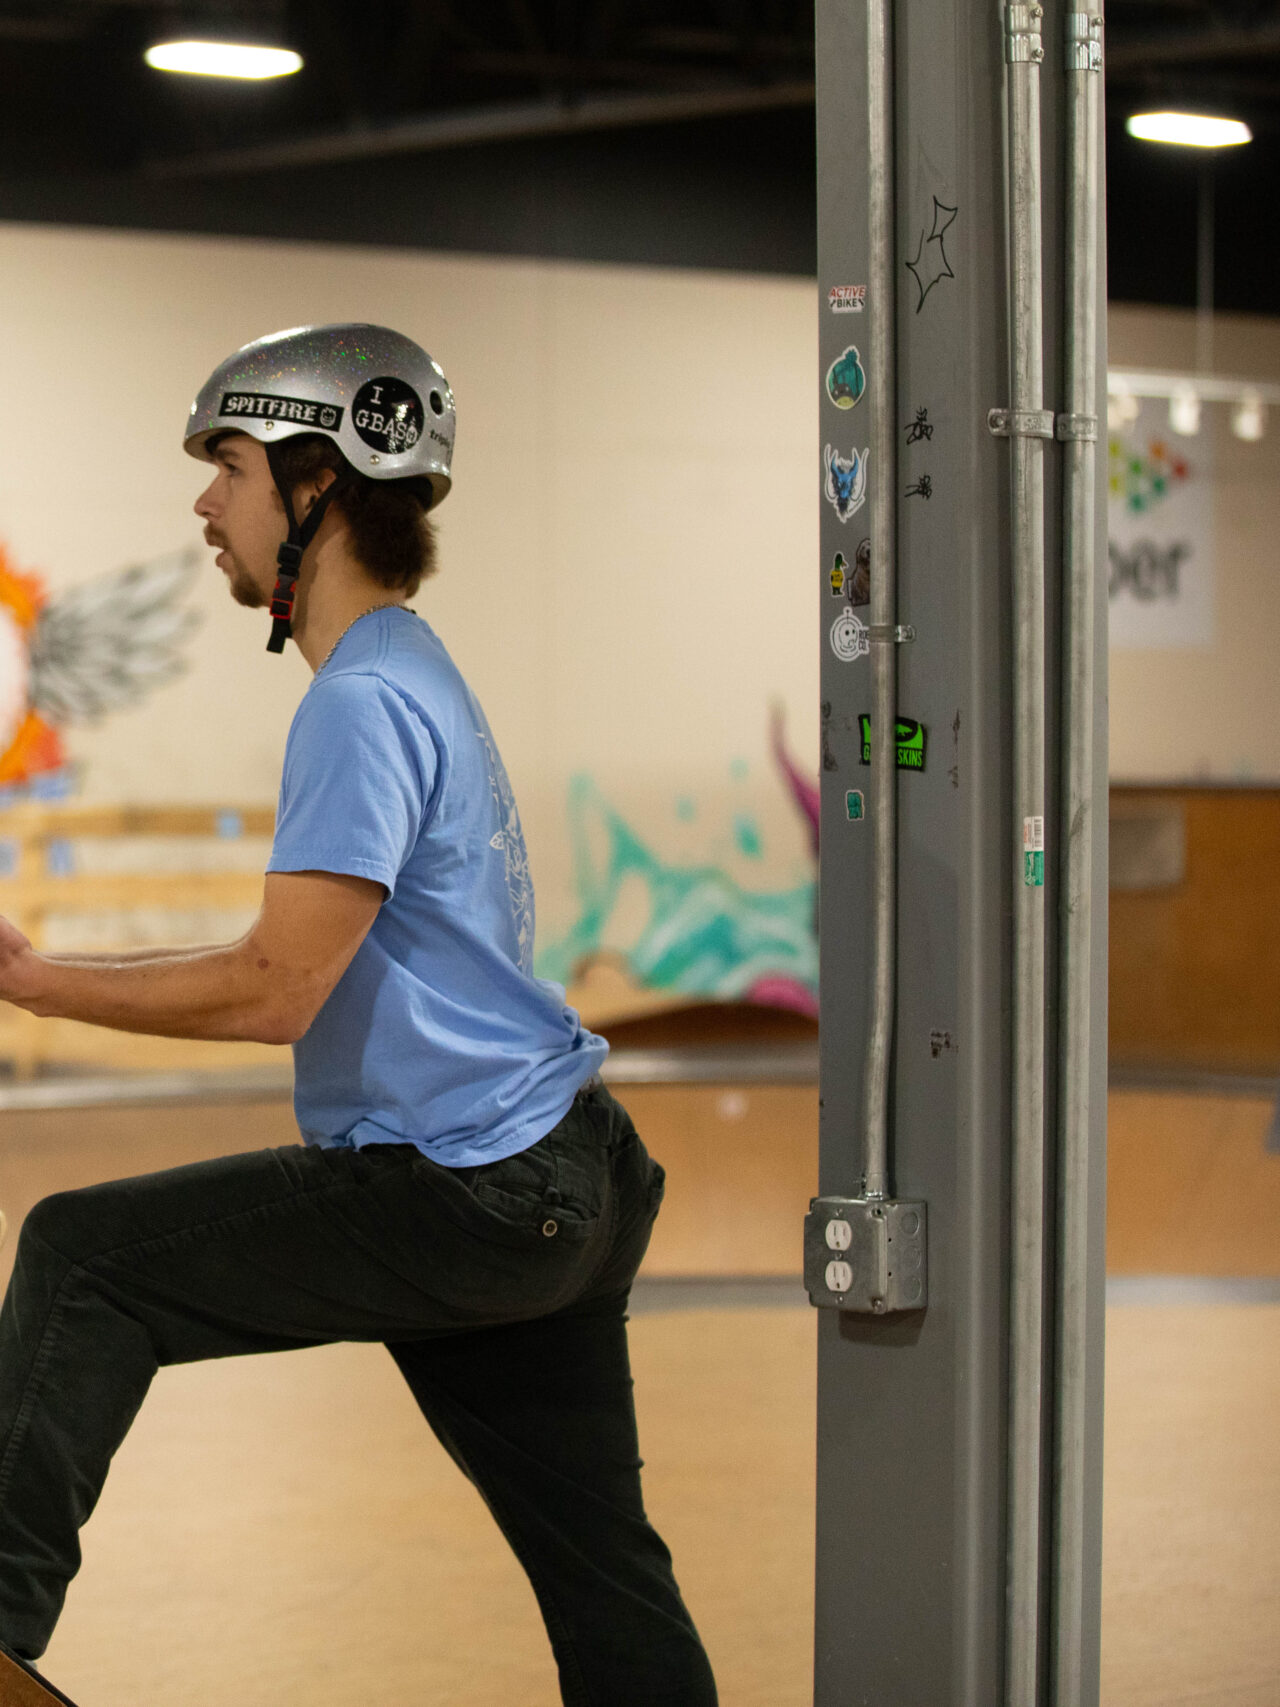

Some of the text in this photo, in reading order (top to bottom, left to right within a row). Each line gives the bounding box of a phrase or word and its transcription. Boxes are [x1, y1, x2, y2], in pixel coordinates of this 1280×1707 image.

[829, 286, 865, 298] ACTIVE
[837, 298, 858, 308] BIKE
[224, 396, 318, 422] SPITFIRE
[897, 748, 923, 768] SKINS
